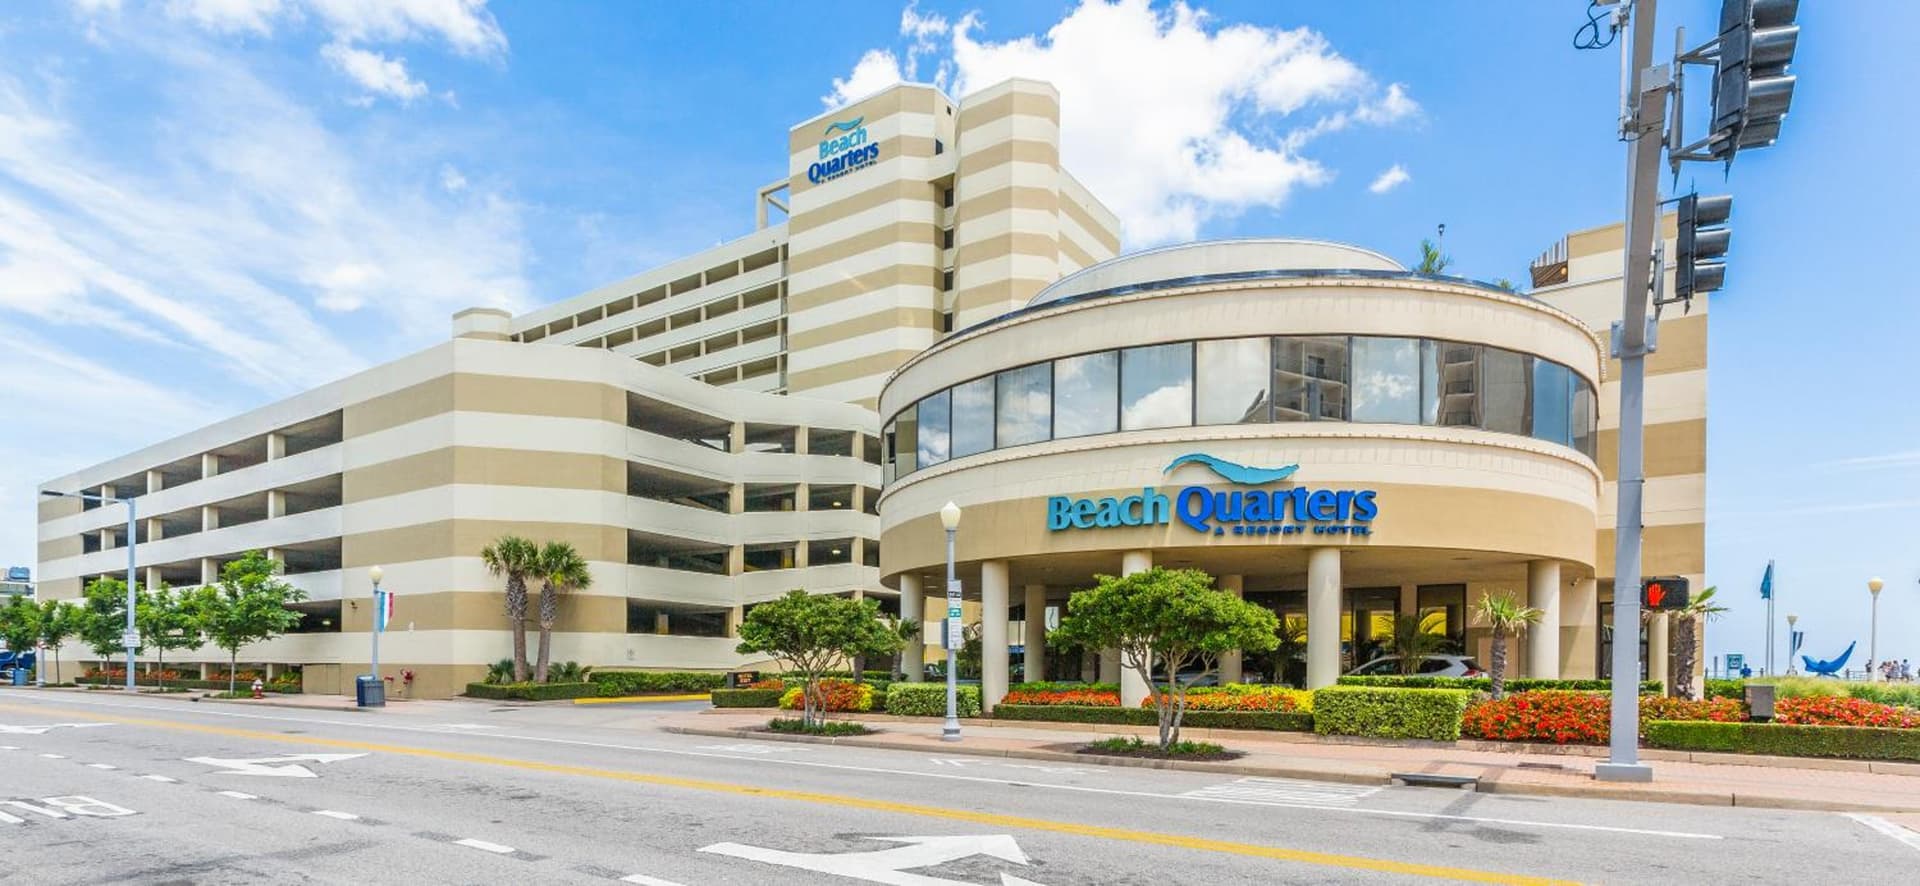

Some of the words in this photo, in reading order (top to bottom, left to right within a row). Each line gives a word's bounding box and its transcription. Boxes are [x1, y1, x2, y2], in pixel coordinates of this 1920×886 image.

[808, 142, 879, 184] Quarters
[819, 127, 867, 160] Beach
[1048, 486, 1170, 532] Beach
[1175, 486, 1378, 532] Quarters
